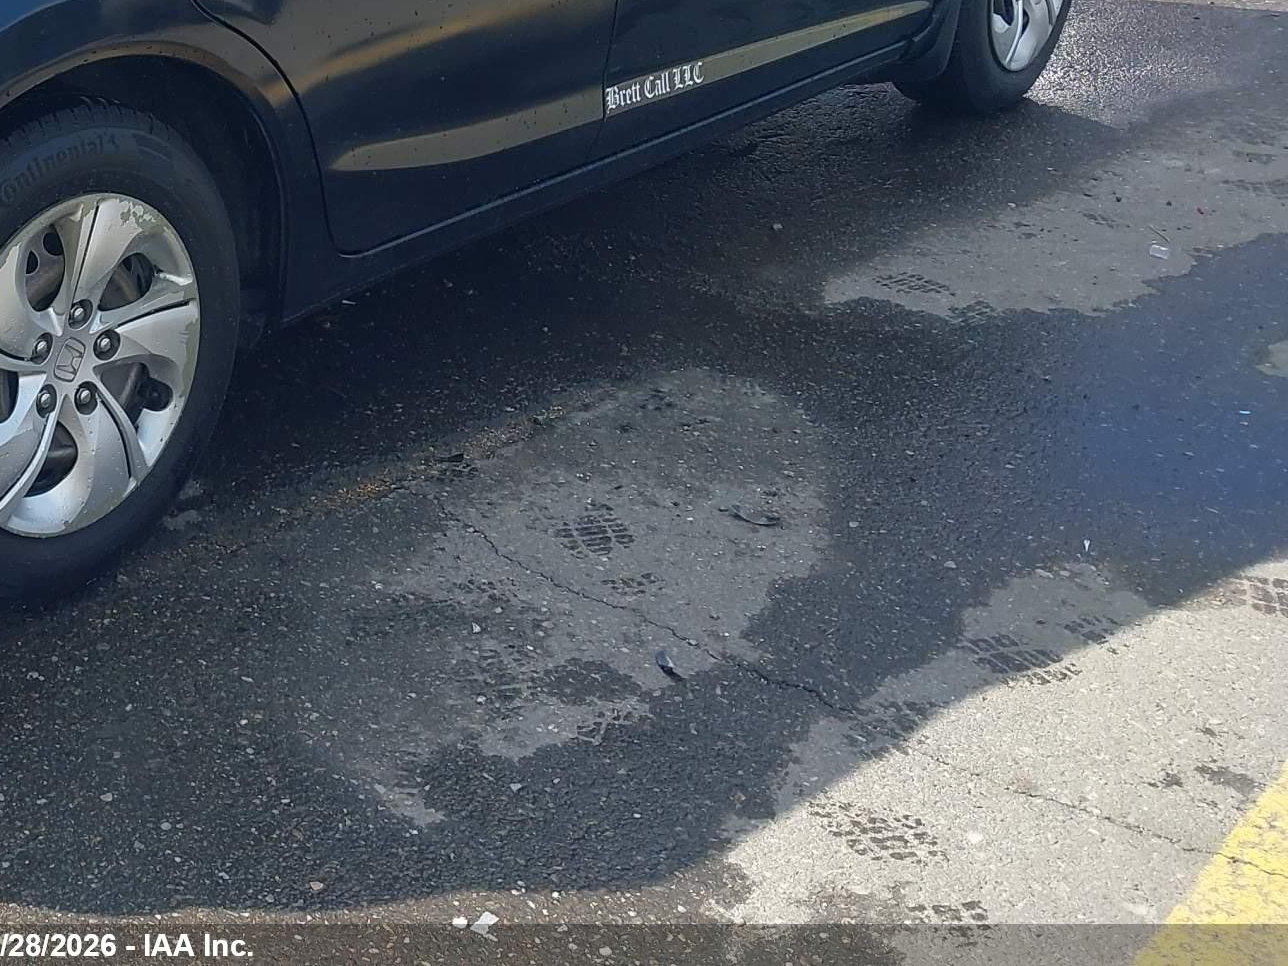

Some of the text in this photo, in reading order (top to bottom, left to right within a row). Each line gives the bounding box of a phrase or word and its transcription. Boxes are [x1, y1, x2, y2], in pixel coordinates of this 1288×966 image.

[605, 62, 705, 113] Brett Call LLC
